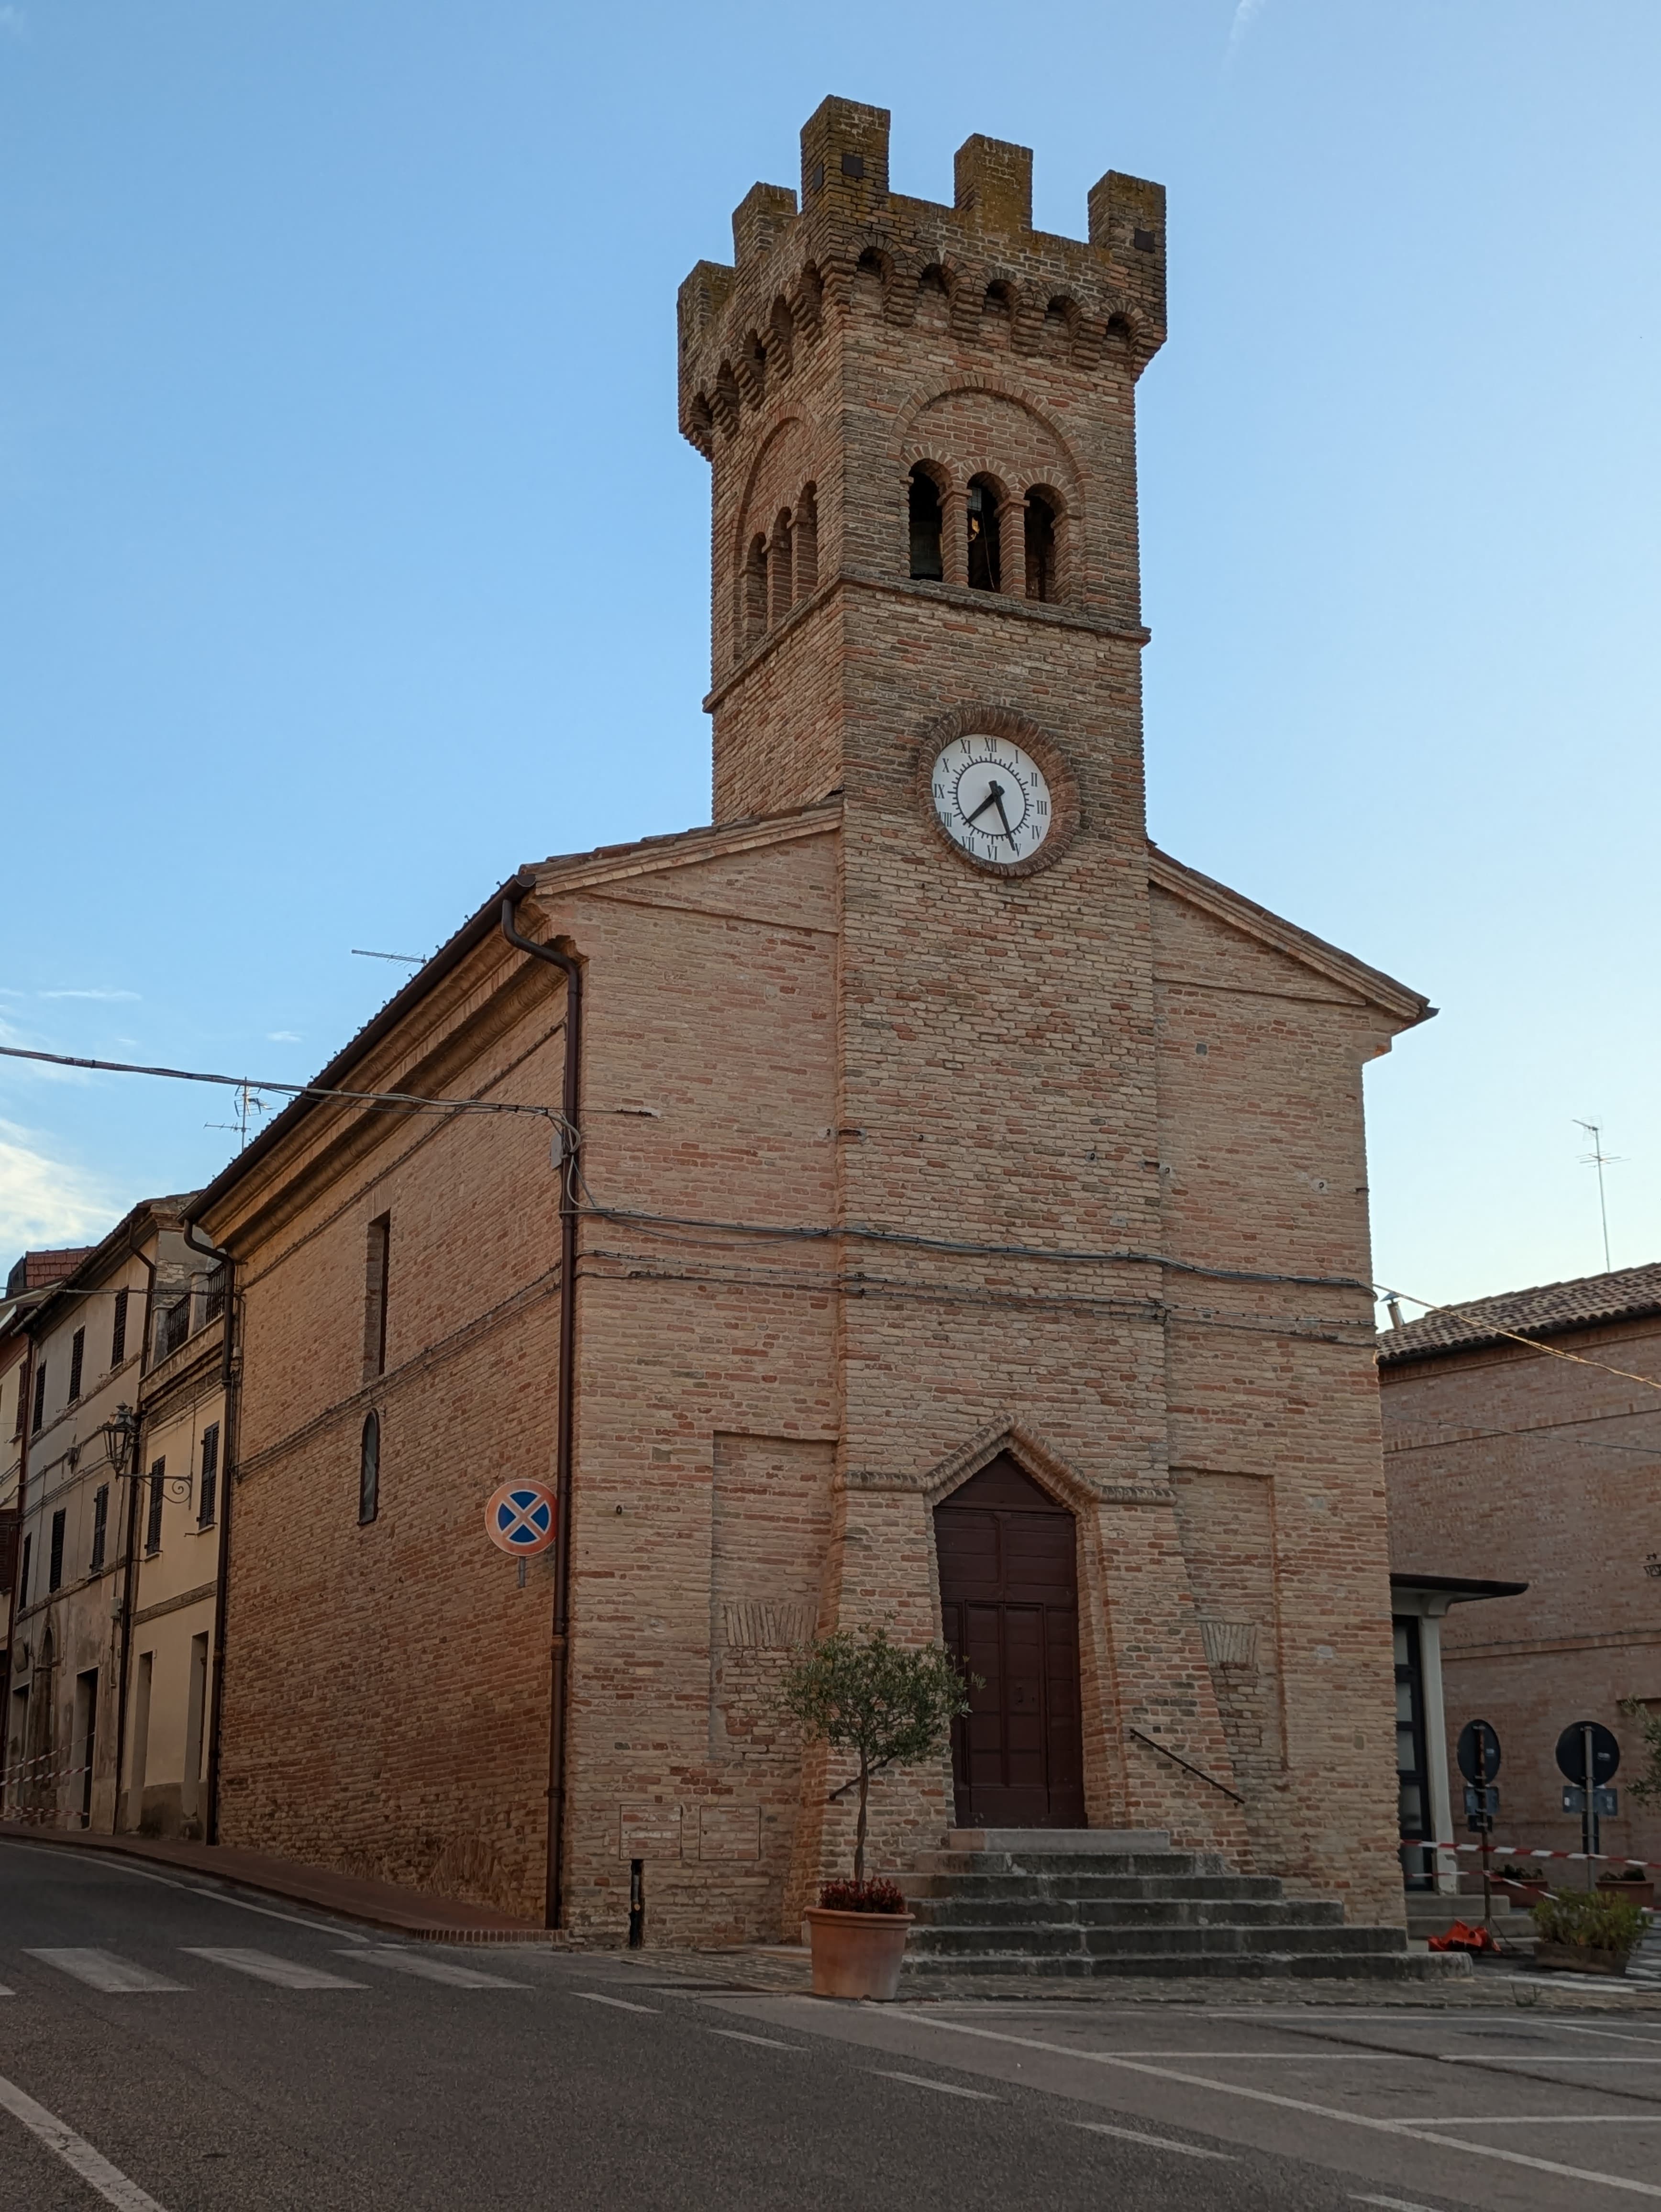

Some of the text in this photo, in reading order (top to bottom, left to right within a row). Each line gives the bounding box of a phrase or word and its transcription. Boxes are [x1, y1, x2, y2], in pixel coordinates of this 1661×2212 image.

[960, 739, 971, 754] XI
[985, 738, 997, 752] XII
[1015, 750, 1019, 763] I
[942, 758, 950, 773] X
[1031, 772, 1038, 787] II
[934, 784, 945, 799] IX
[1036, 800, 1047, 815] III
[1032, 825, 1041, 840] IV
[962, 836, 974, 852] VII
[1014, 843, 1021, 857] V
[987, 845, 997, 861] VI
